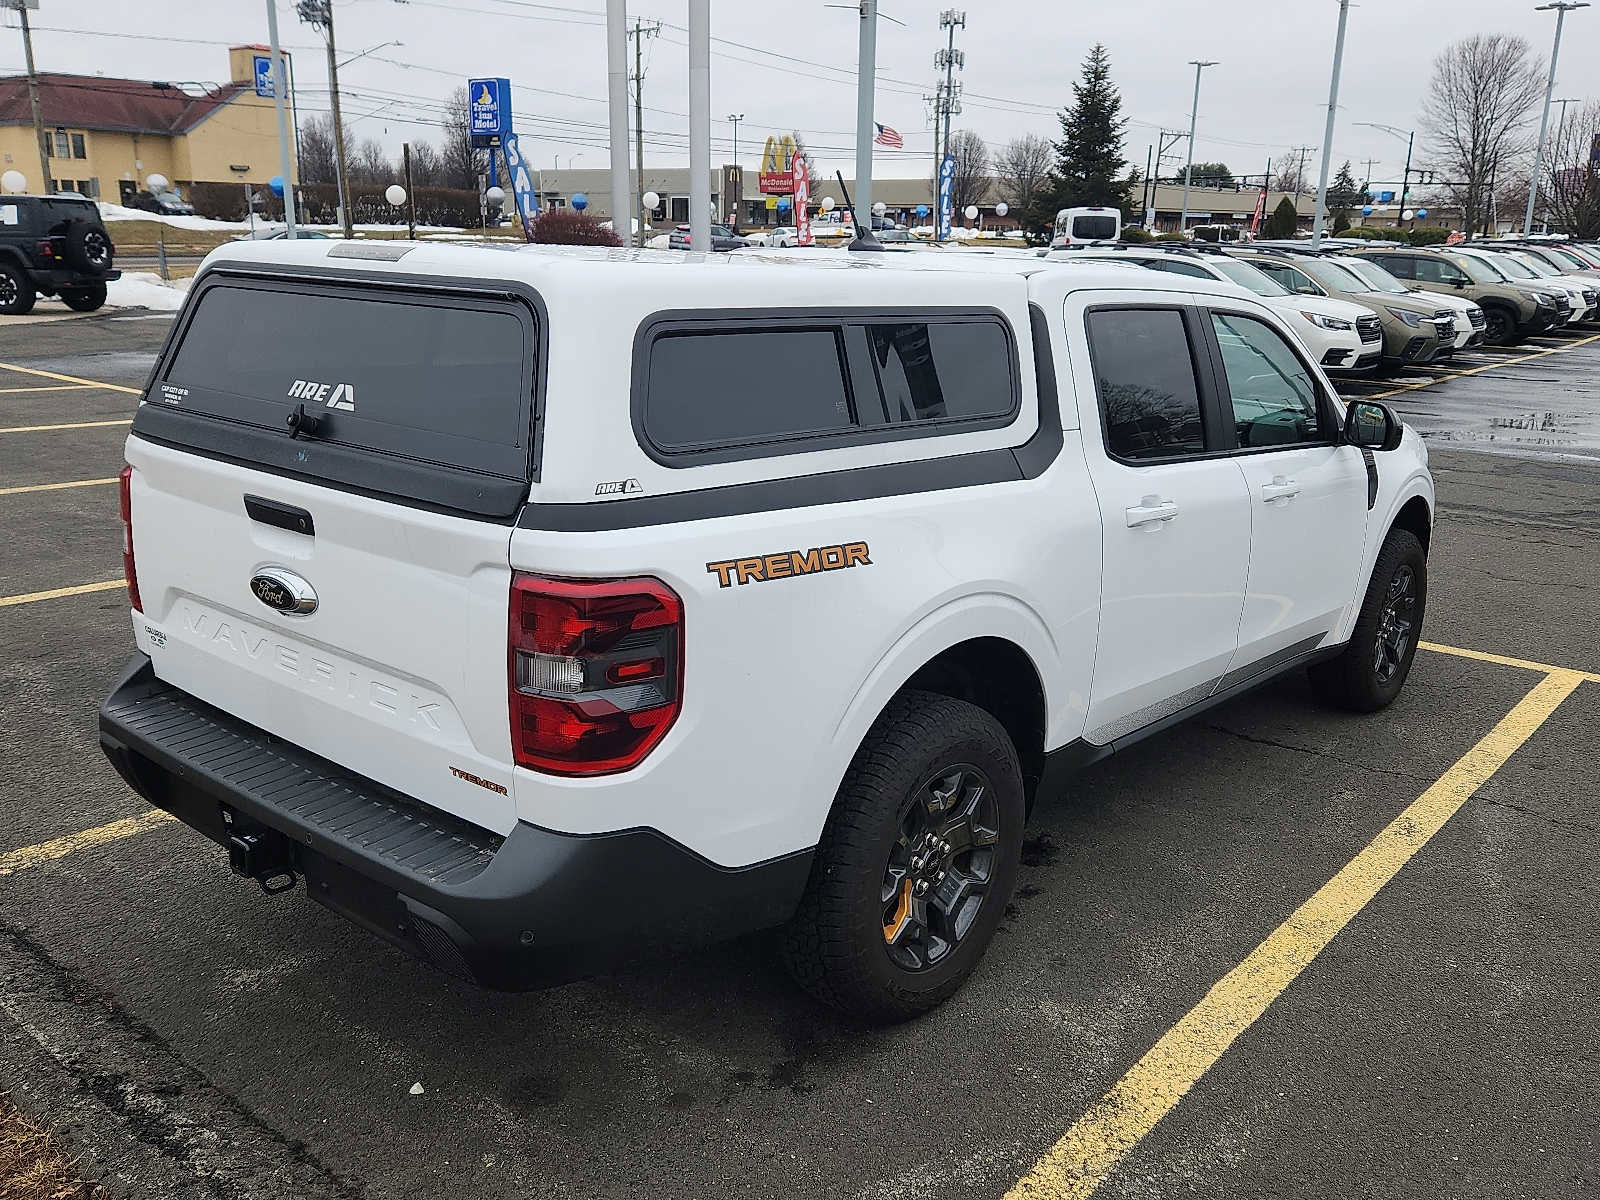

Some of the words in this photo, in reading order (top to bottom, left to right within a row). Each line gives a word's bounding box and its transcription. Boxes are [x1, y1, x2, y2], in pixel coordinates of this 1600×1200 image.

[472, 101, 498, 112] Travel
[474, 120, 497, 129] Motel
[507, 139, 536, 218] SAL
[794, 158, 808, 242] SALE
[941, 160, 954, 234] SALE
[288, 379, 331, 402] ARE
[595, 481, 625, 495] ARE
[706, 541, 874, 588] TREMOR
[257, 580, 284, 605] Ford
[183, 607, 442, 733] MAVERICK
[449, 766, 509, 797] TREMOR
